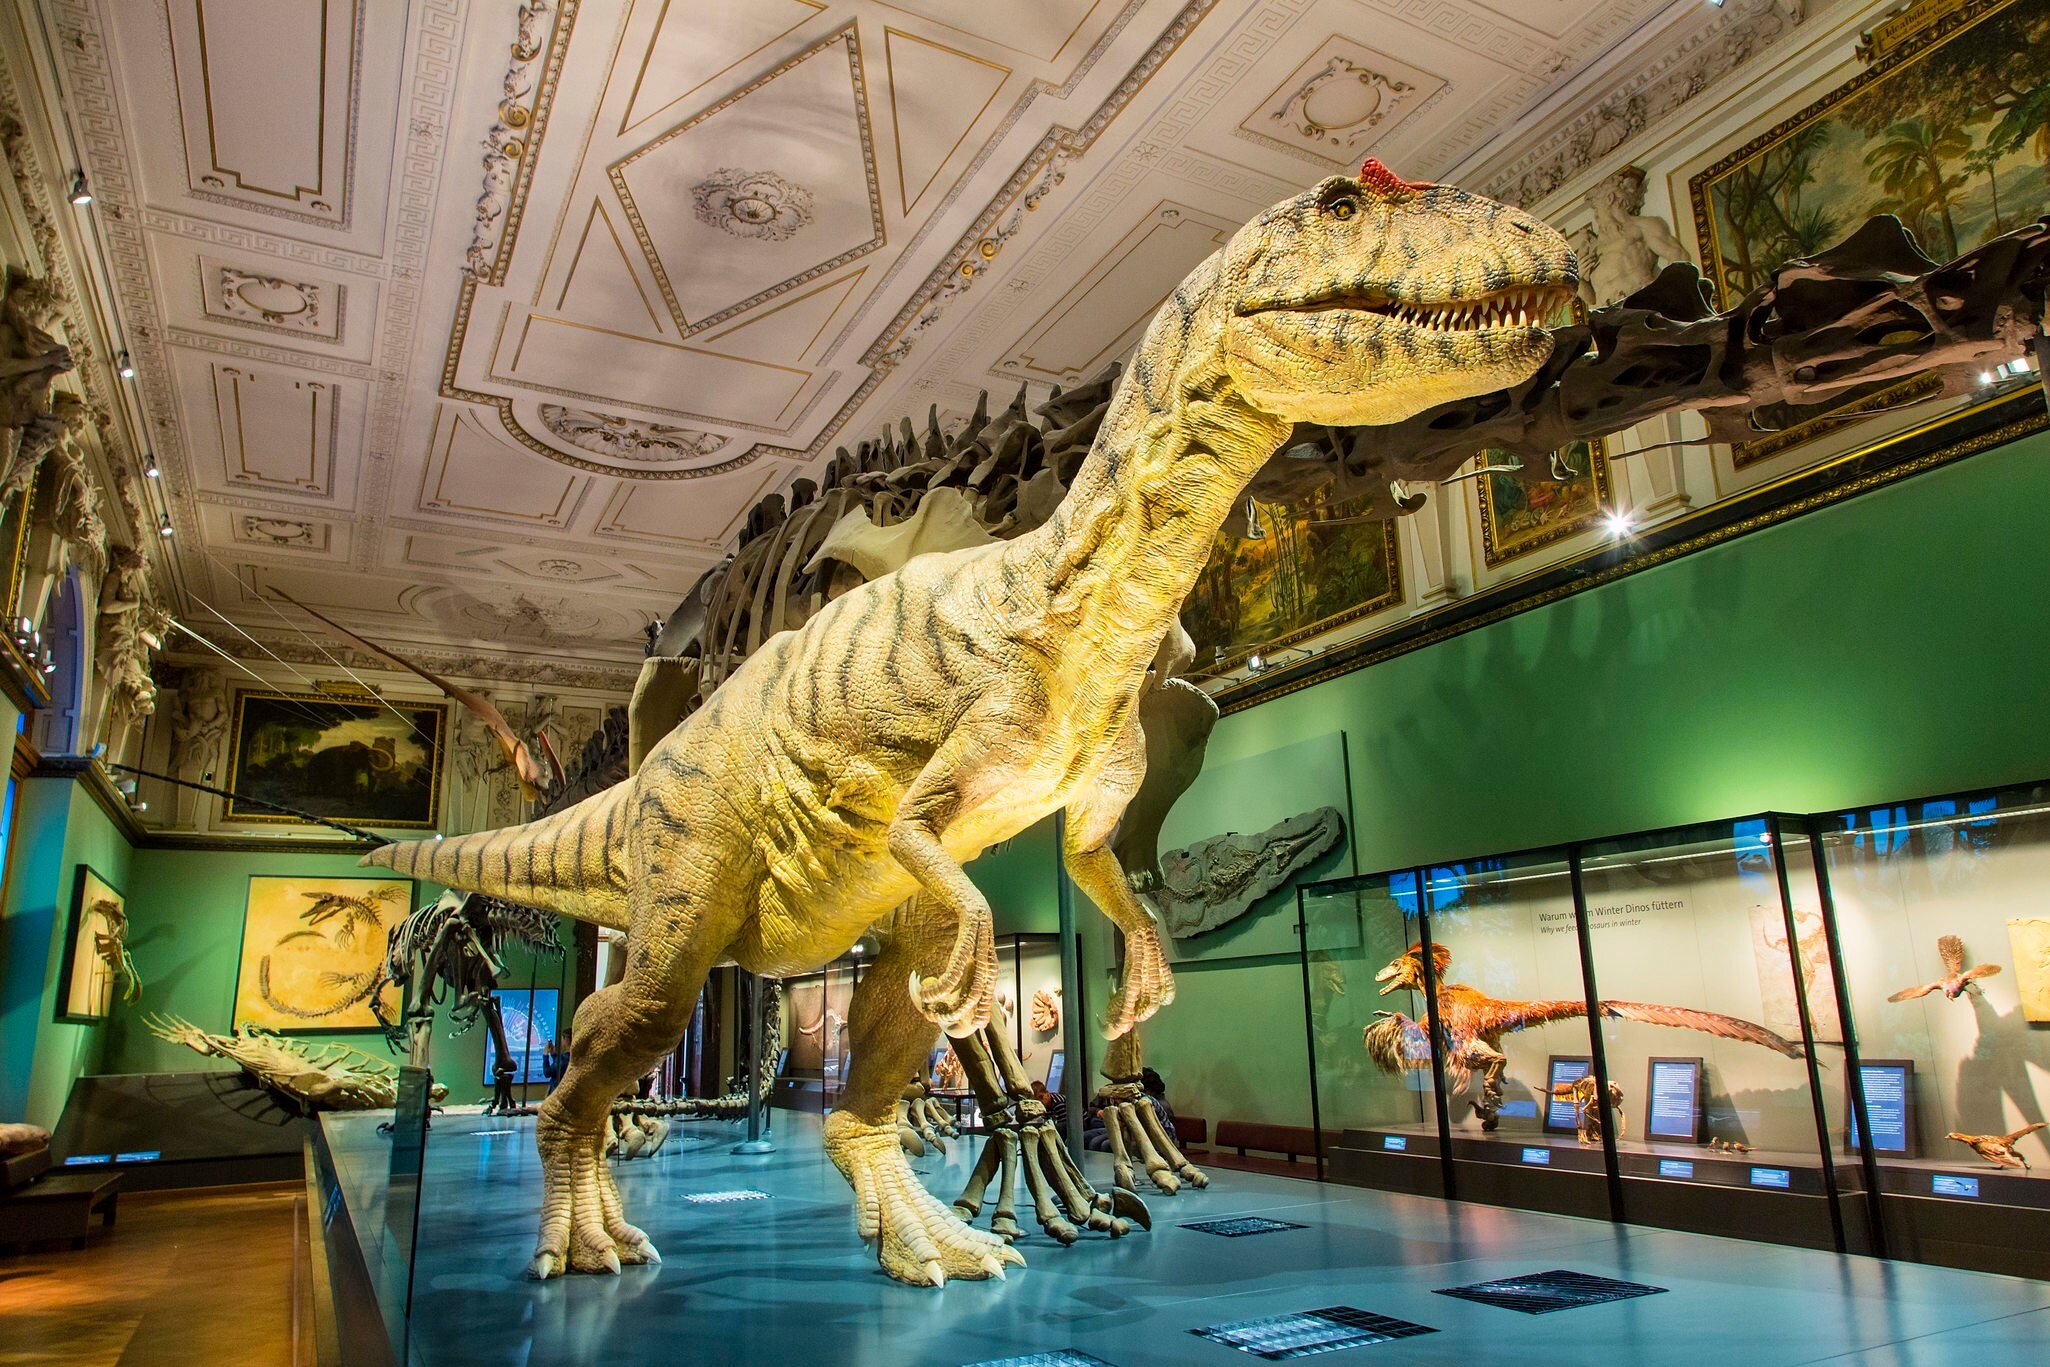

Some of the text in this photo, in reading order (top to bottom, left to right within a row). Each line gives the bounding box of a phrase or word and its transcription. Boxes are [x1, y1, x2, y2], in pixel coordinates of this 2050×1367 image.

[1539, 911, 1567, 922] Warum
[1595, 906, 1623, 916] Winter
[1625, 903, 1650, 913] Dinos
[1651, 900, 1684, 911] füttern
[1540, 925, 1554, 935] Why
[1589, 921, 1610, 930] osaurs
[1620, 918, 1641, 926] winter
